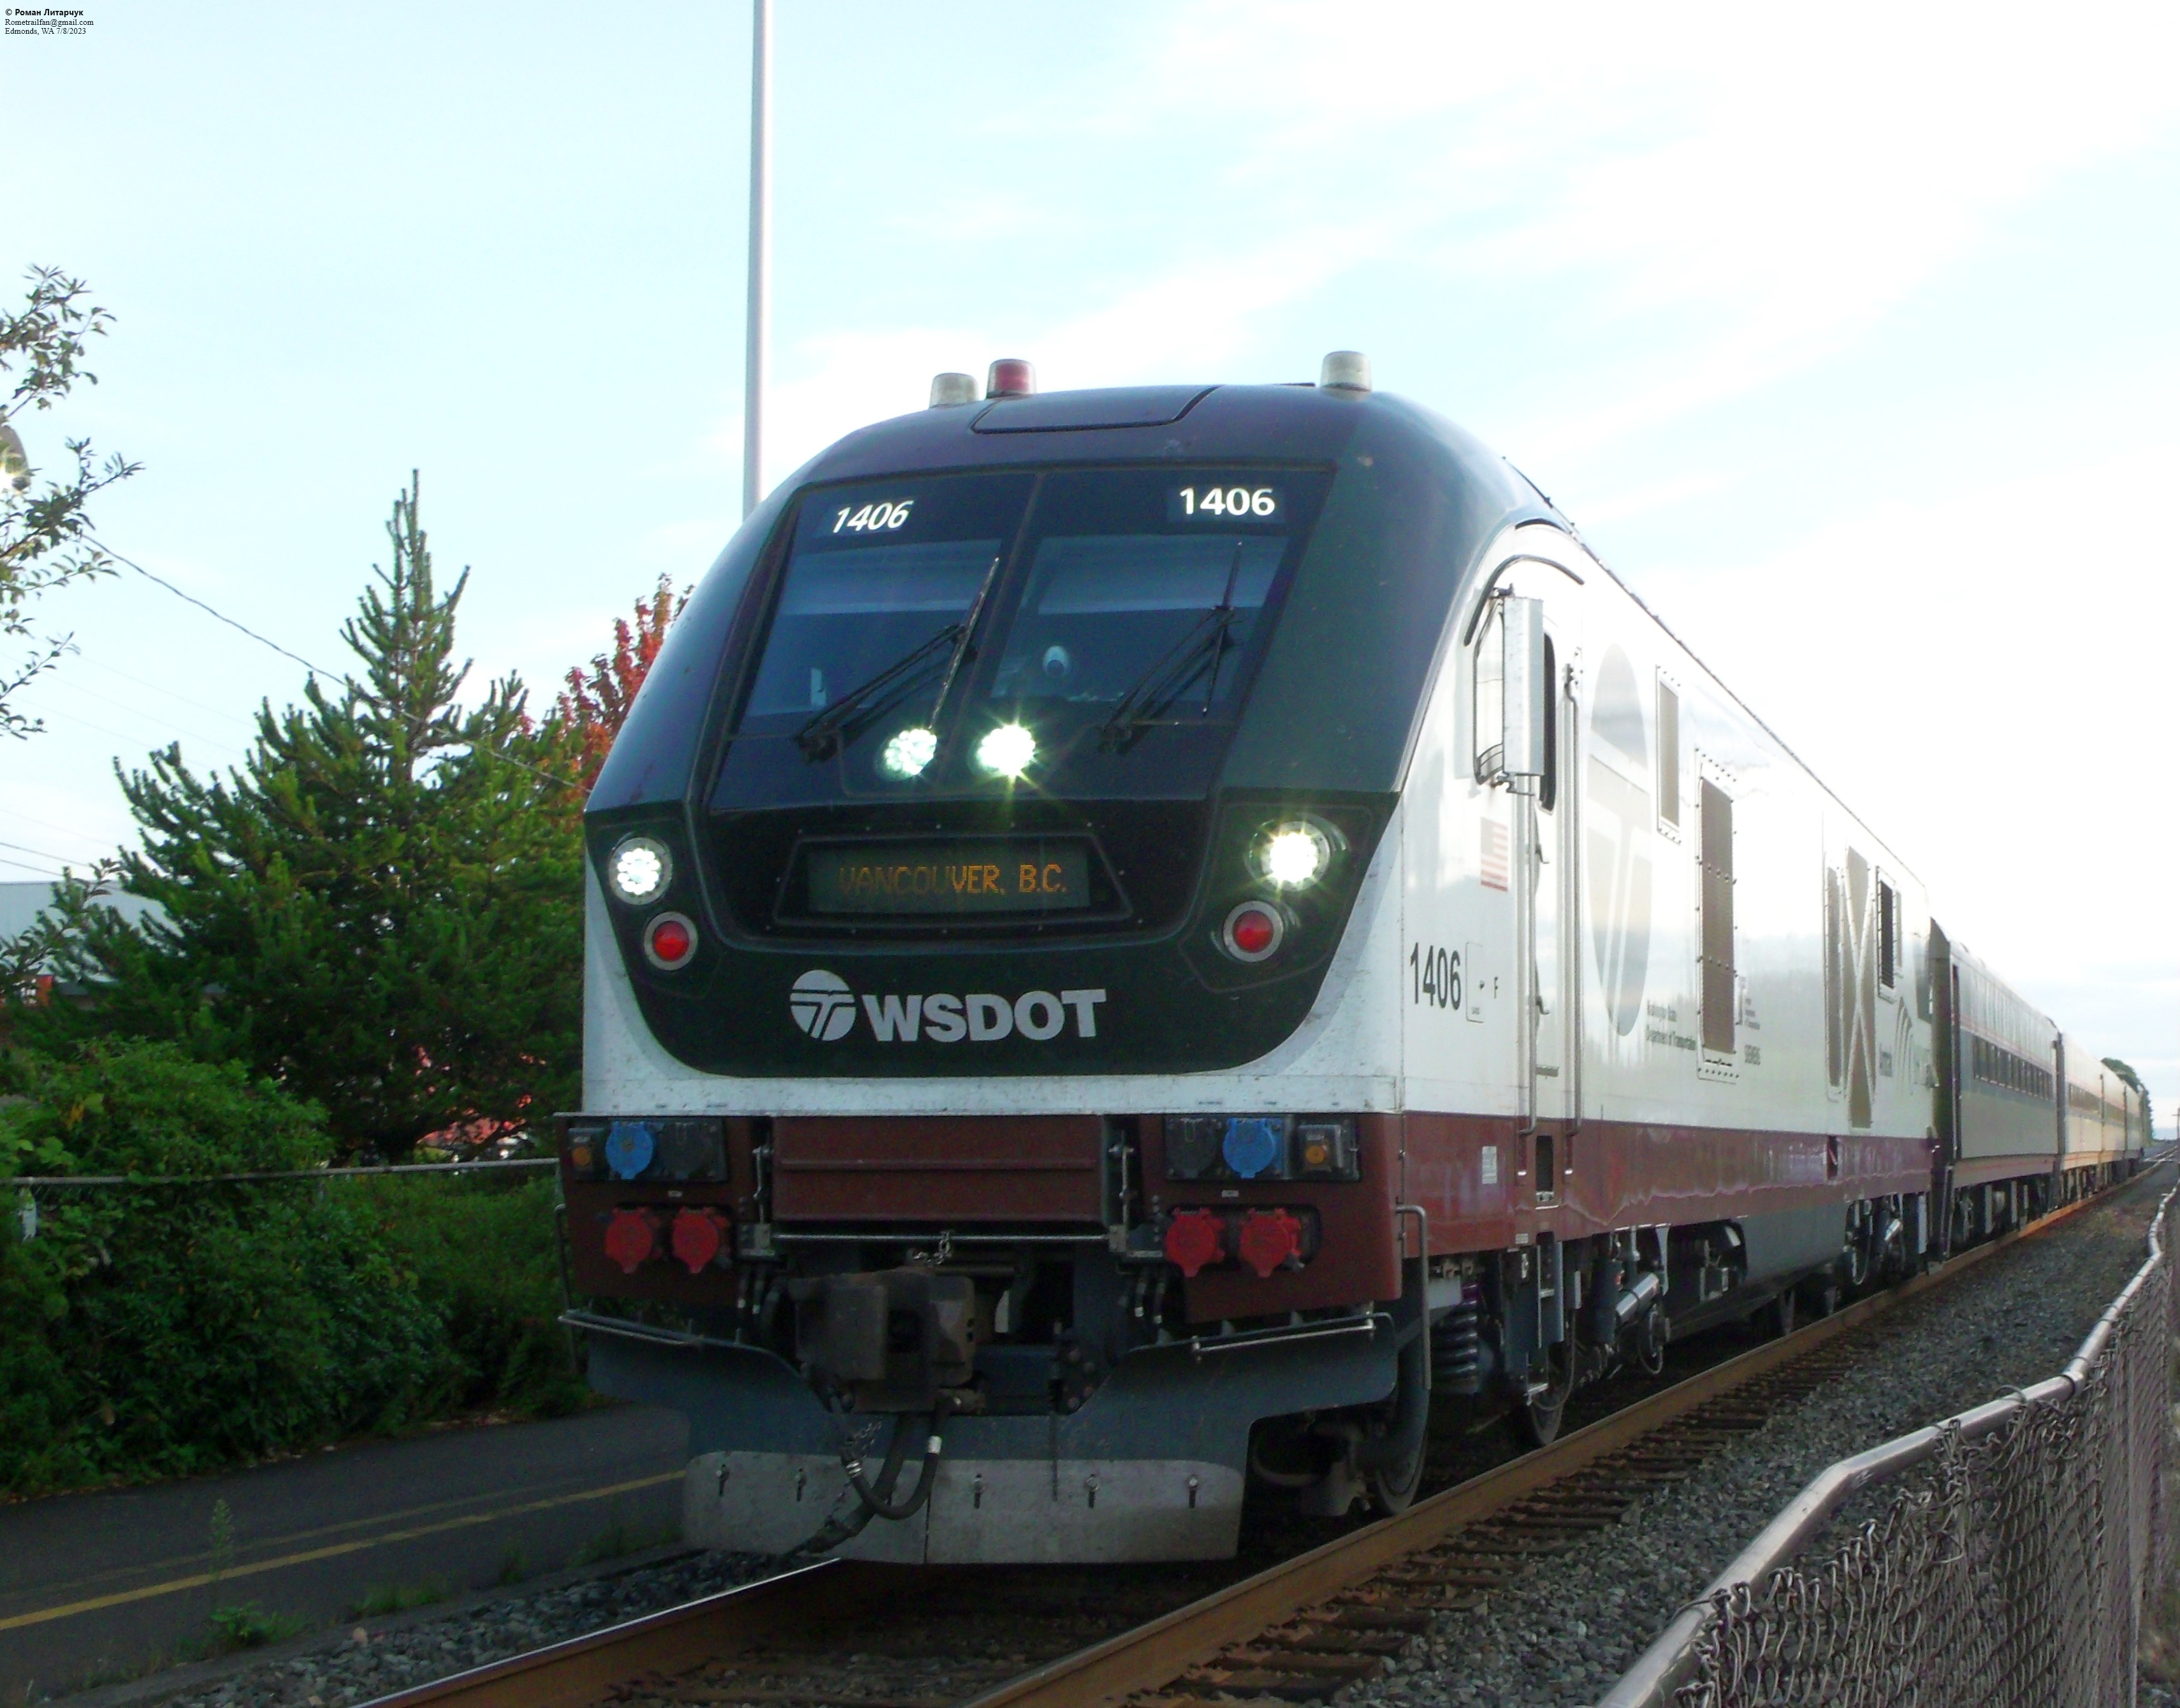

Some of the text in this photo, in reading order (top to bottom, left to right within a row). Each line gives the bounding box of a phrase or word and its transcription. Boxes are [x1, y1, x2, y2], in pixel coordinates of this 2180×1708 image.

[832, 500, 915, 534] 1406
[1179, 487, 1275, 516] 1406
[1019, 863, 1068, 893] B.C.
[1409, 942, 1462, 1011] 1406
[862, 988, 1107, 1043] WSDOT
